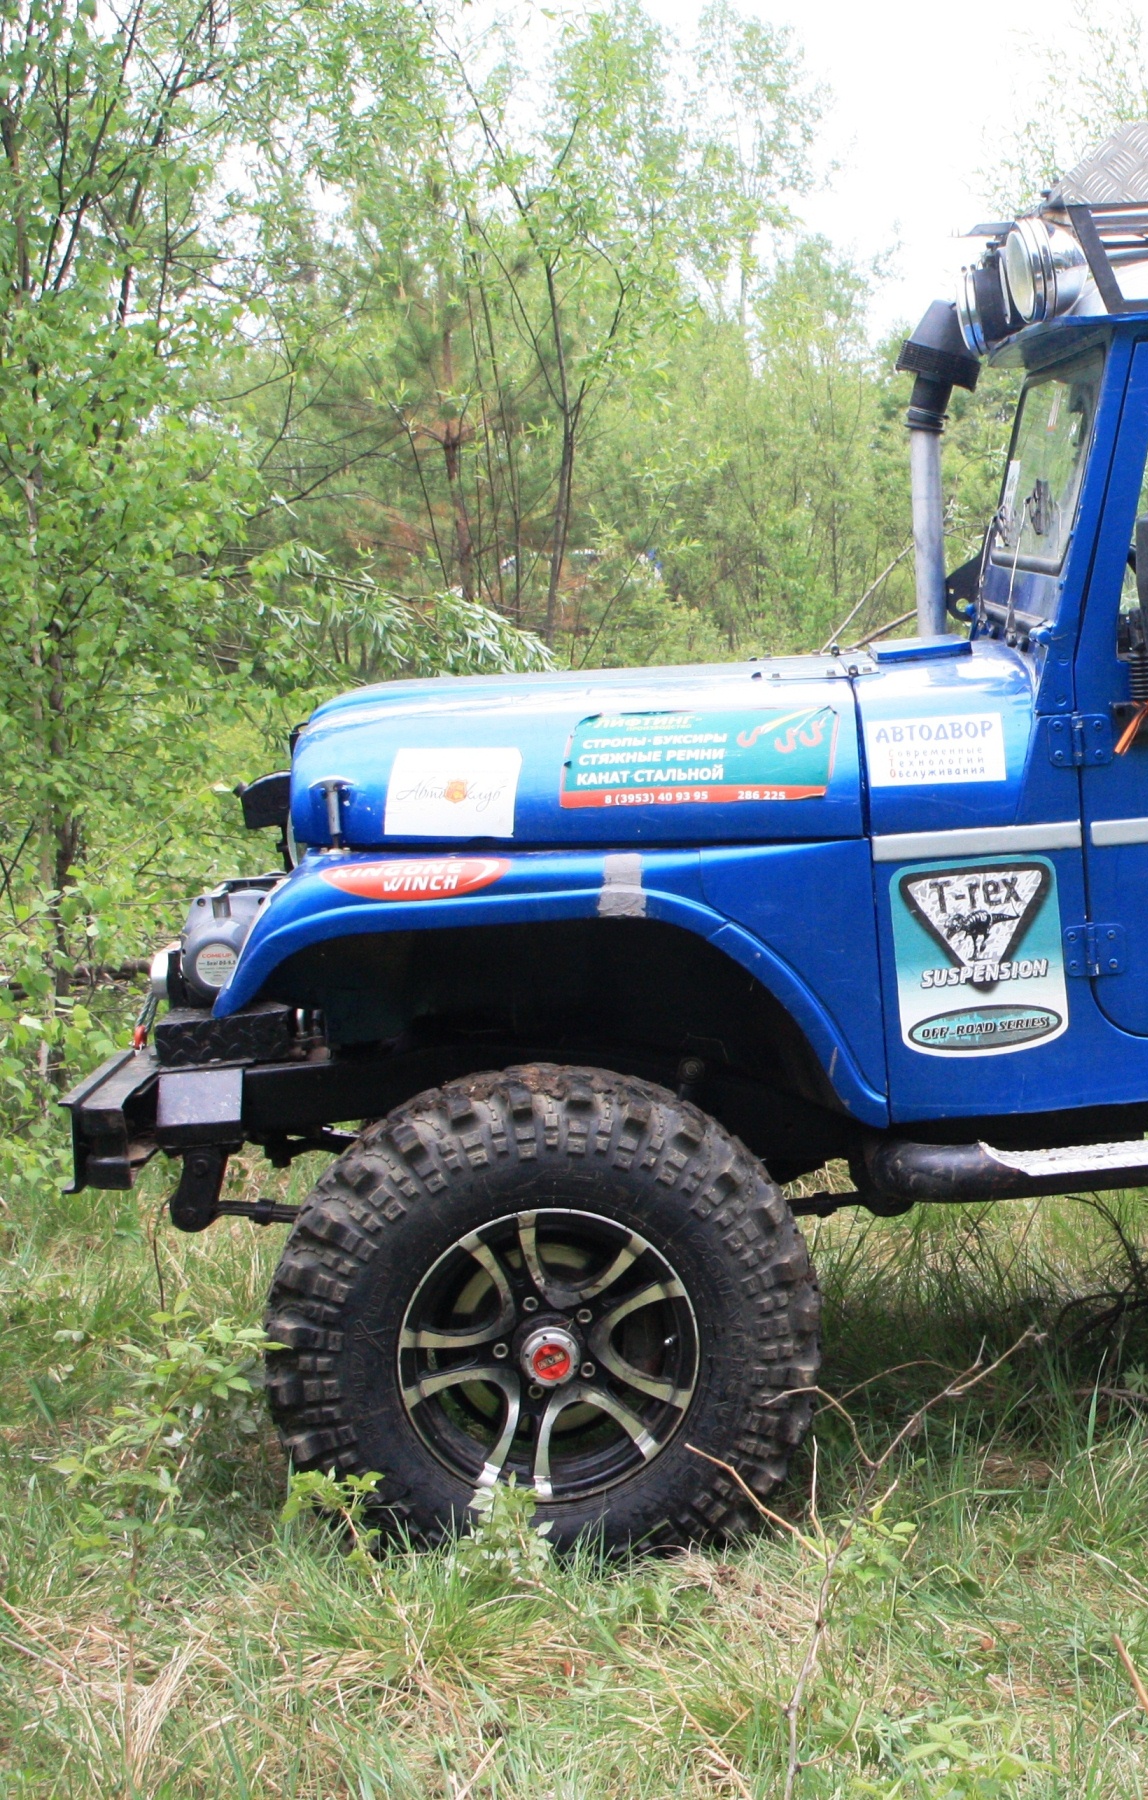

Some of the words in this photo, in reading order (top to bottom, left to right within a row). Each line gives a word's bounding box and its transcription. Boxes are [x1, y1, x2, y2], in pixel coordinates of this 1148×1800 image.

[875, 720, 993, 743] АВТОДВОР
[578, 750, 662, 766] СТЯЖНЫЕ
[666, 748, 726, 762] РЕМНИ
[888, 746, 982, 759] Современные
[889, 756, 984, 768] Технологии
[576, 770, 631, 786] КАНАТ
[634, 764, 724, 784] СТАЛЬНОЙ
[889, 766, 985, 779] Обслуживания
[604, 794, 612, 804] 8
[615, 792, 655, 805] (3953)
[658, 792, 673, 802] 40
[676, 791, 691, 801] 93
[694, 791, 709, 801] 95
[737, 790, 760, 800] 286
[763, 790, 786, 800] 225
[332, 861, 467, 879] KINGONE
[382, 875, 460, 892] WINCH
[921, 958, 1049, 989] SUSPENSION
[999, 1016, 1051, 1032] SERIES
